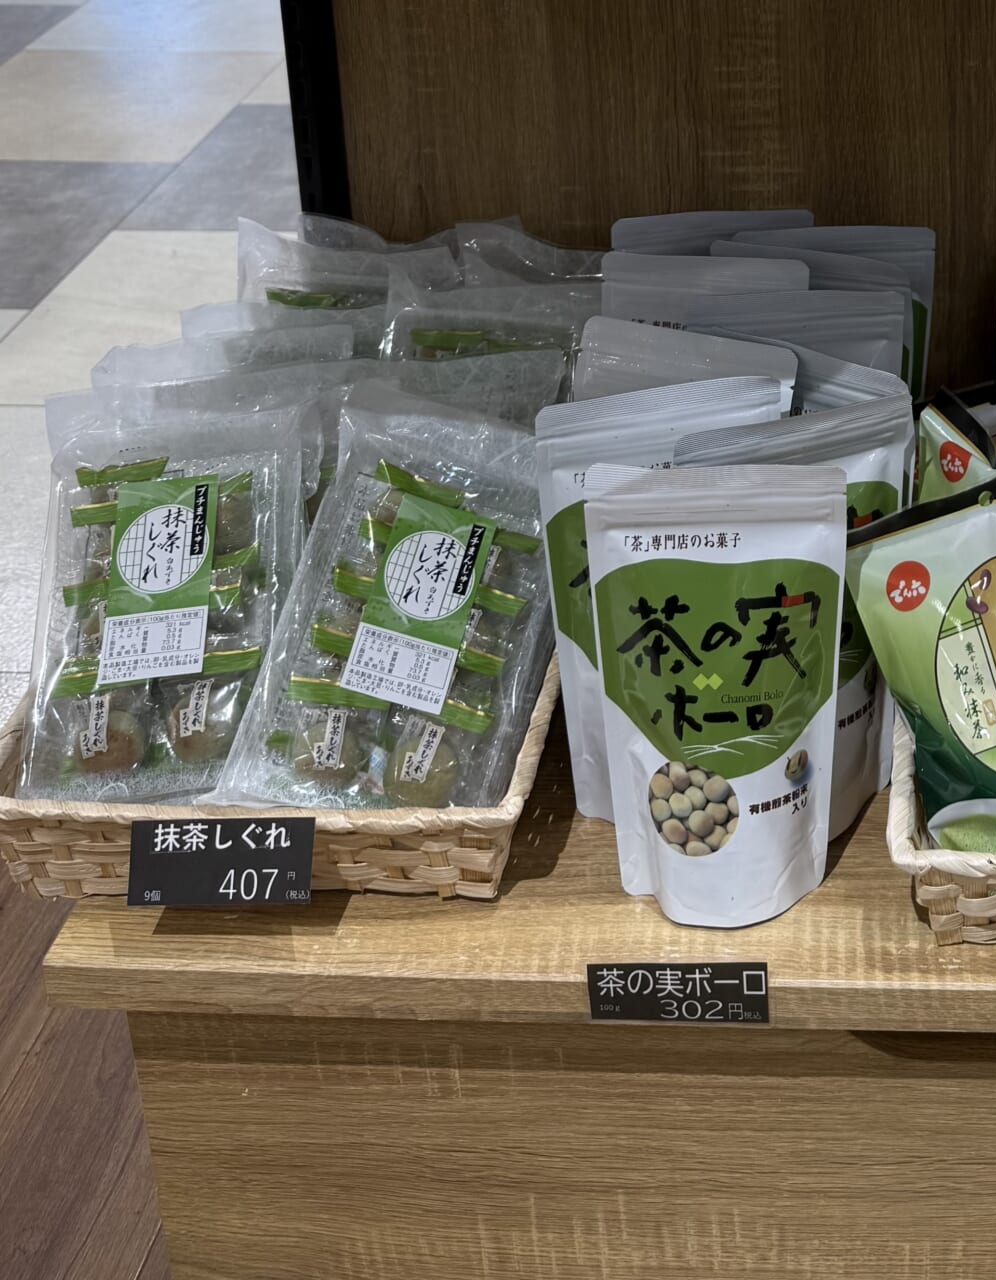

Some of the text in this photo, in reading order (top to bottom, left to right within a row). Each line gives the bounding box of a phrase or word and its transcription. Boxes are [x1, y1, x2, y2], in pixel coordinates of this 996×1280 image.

[623, 532, 741, 553] 「茶」専門店のお菓子
[616, 582, 822, 688] 茶の実
[721, 688, 784, 704] Chanomi Bolo
[153, 822, 291, 852] 抹茶しぐれ
[143, 868, 296, 902] 9個 407 円
[285, 890, 310, 900] (税込)
[596, 967, 766, 998] 茶の実ボーロ
